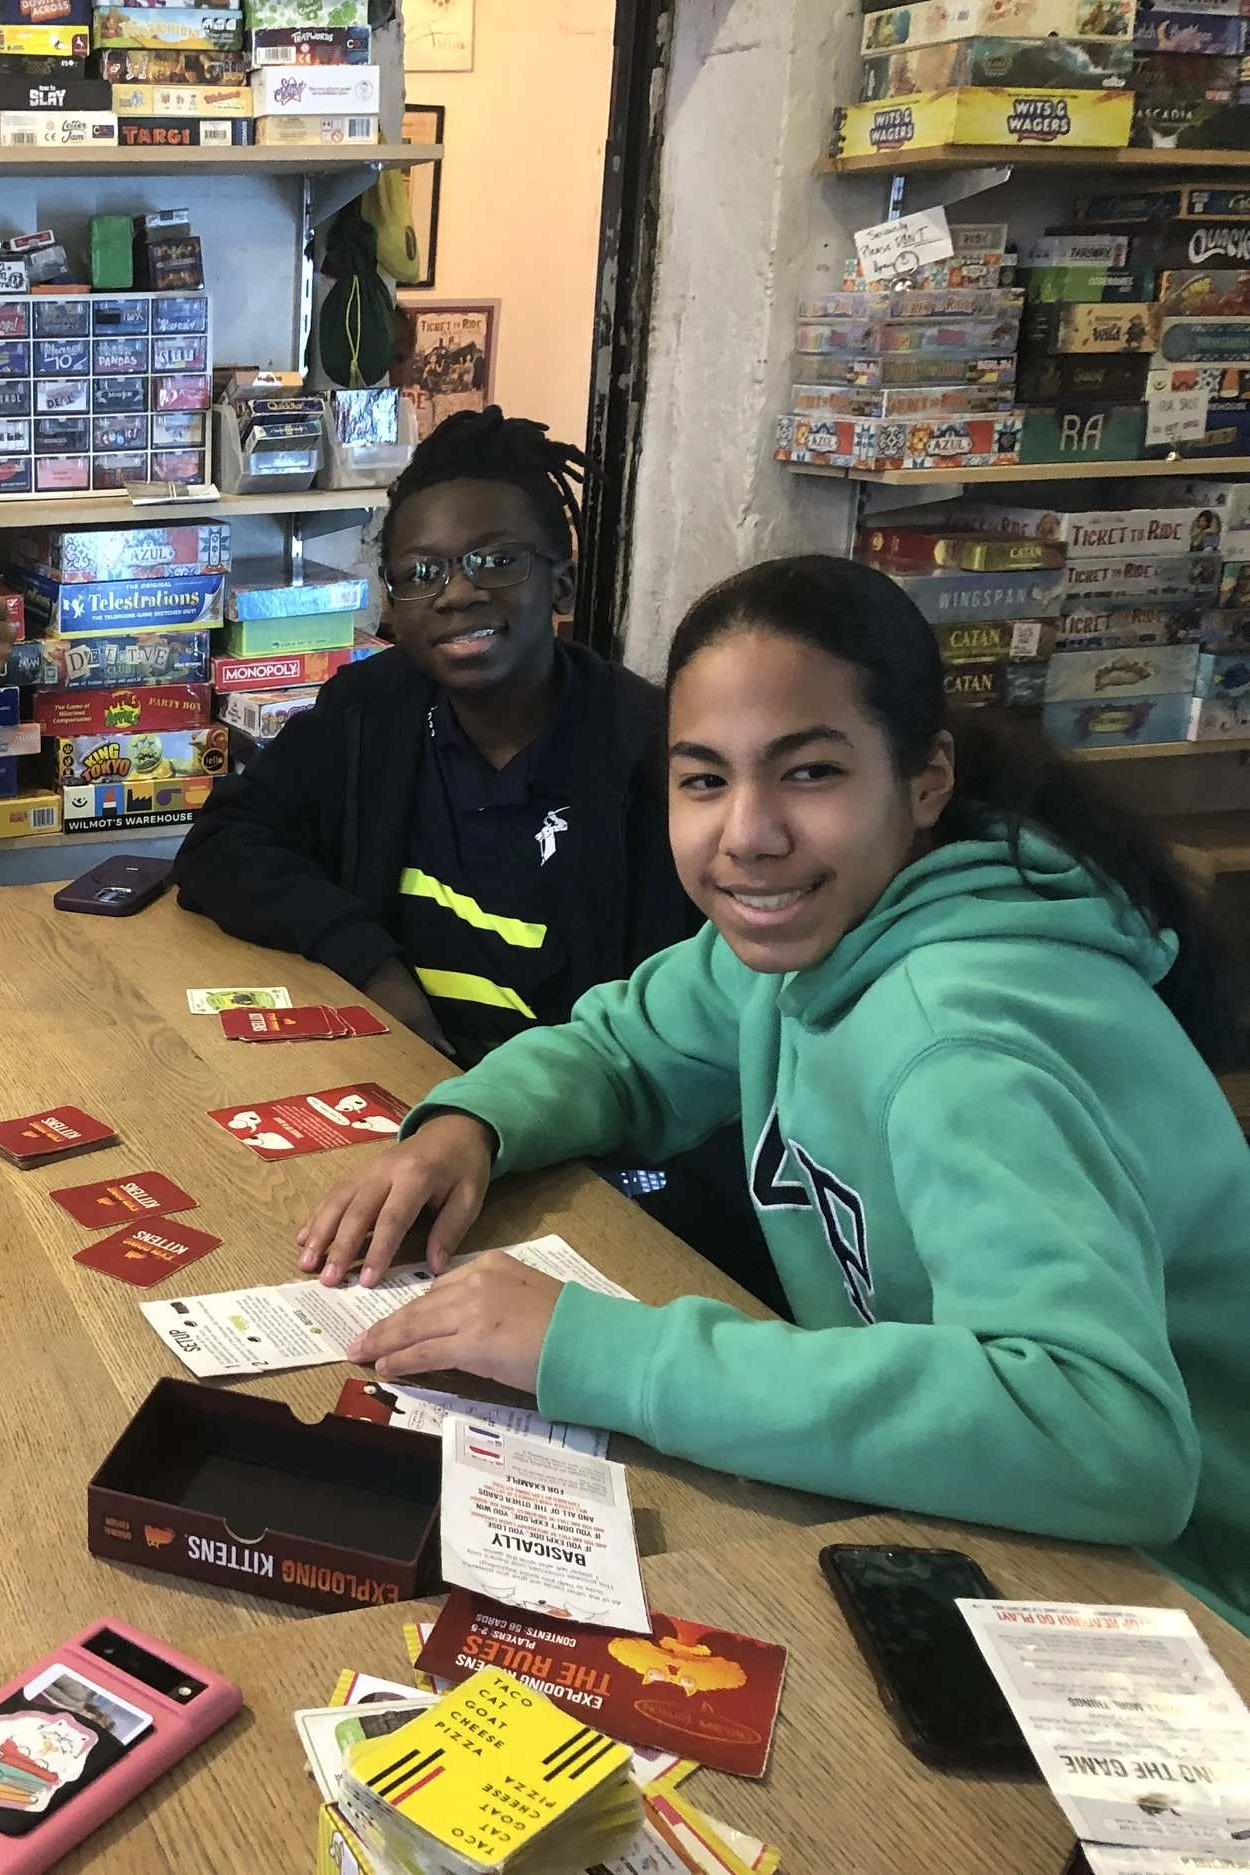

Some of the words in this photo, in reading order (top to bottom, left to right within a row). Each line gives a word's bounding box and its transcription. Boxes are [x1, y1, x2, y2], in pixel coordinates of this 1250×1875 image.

[291, 32, 334, 43] TRAPWORDS
[29, 89, 67, 107] SLAY
[1013, 99, 1053, 114] WITS
[1008, 115, 1070, 133] WAGERS
[122, 126, 190, 145] TARGI
[421, 319, 450, 332] TICKET
[462, 319, 482, 331] RIDE
[54, 354, 73, 370] 10
[98, 355, 138, 366] PANDAS
[812, 435, 834, 447] AZUL
[1060, 413, 1104, 451] RA
[934, 439, 964, 450] AZUL
[1072, 525, 1128, 546] TICKET
[1147, 519, 1182, 541] RIDE
[130, 547, 167, 561] AZUL
[1067, 566, 1109, 584] TICKET
[1123, 563, 1152, 579] RIDE
[89, 590, 200, 612] Telestrations
[939, 587, 1028, 609] WINGSPAN
[951, 628, 1000, 648] CATAN
[107, 664, 131, 673] CLUB
[225, 664, 298, 680] MONOPOLY
[944, 673, 994, 693] CATAN
[67, 703, 82, 711] Game
[148, 697, 177, 709] PARTY
[179, 700, 201, 711] BOX
[52, 716, 93, 724] Comparisons!
[84, 743, 121, 766] KING
[82, 758, 132, 783] TOKYO
[68, 817, 123, 830] WILMOT'S
[125, 812, 193, 826] WAREHOUSE
[120, 1182, 161, 1209] KITTENS
[132, 1230, 189, 1255] KITTENS
[168, 1329, 201, 1353] SETUP
[505, 1475, 546, 1492] EXAMPLE
[548, 1486, 565, 1496] FOR
[478, 1488, 504, 1500] CARDS
[505, 1497, 531, 1509] OTHER
[493, 1508, 509, 1517] YOU
[533, 1504, 548, 1513] THE
[563, 1510, 577, 1519] ALL
[578, 1514, 595, 1523] AND
[508, 1525, 524, 1536] YOU
[576, 1528, 592, 1537] YOU
[491, 1532, 586, 1567] BASICALLY
[566, 1541, 583, 1551] YOU
[188, 1535, 275, 1579] KITTENS
[282, 1559, 400, 1605] EXPLODING
[475, 1613, 506, 1629] CARDS
[997, 1611, 1035, 1623] PLAY!
[1037, 1613, 1055, 1625] GO
[508, 1622, 521, 1633] 56
[492, 1631, 536, 1650] PLAYERS:
[525, 1627, 577, 1648] CONTENTS:
[462, 1634, 553, 1681] RULES
[555, 1661, 611, 1697] THE
[479, 1689, 508, 1711] CAT
[493, 1677, 534, 1707] TACO
[518, 1674, 604, 1710] EXPLODING
[465, 1700, 508, 1729] GOAT
[434, 1720, 483, 1757] PIZZA
[450, 1711, 506, 1749] CHEESE
[1060, 1754, 1129, 1778] GAME
[1133, 1760, 1178, 1782] THE
[481, 1783, 541, 1819] CHEESE
[505, 1775, 557, 1808] PIZZA
[479, 1803, 526, 1831] GOAT
[451, 1826, 495, 1856] TACO
[478, 1823, 511, 1842] CAT
